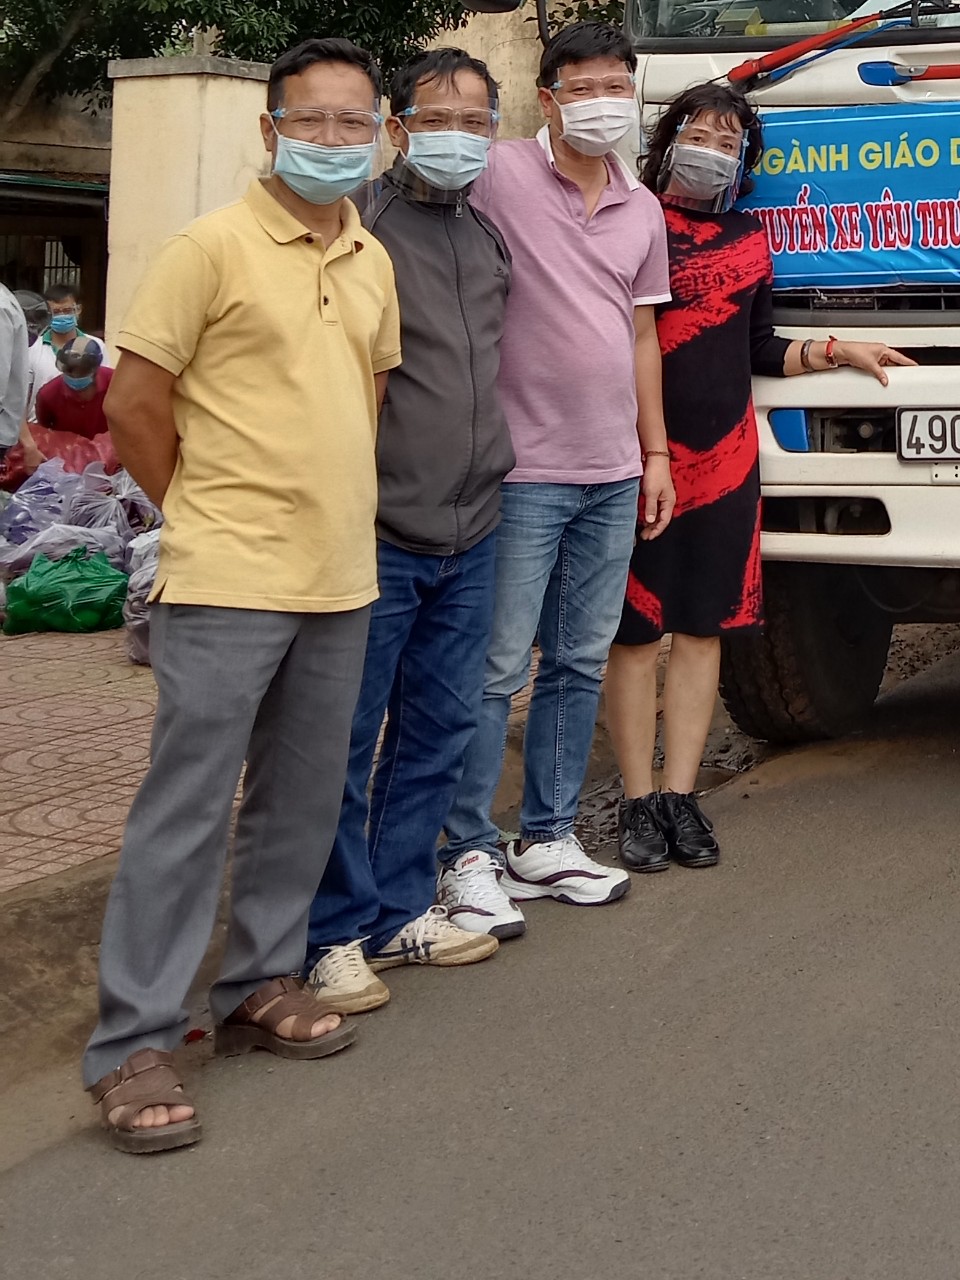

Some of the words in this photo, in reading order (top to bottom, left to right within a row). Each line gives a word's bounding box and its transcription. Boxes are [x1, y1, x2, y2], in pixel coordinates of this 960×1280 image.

[751, 138, 849, 176] GÀNH
[858, 131, 940, 170] GIÁO
[742, 184, 828, 254] UYẾN
[829, 202, 864, 252] XE
[864, 187, 912, 252] YÊU
